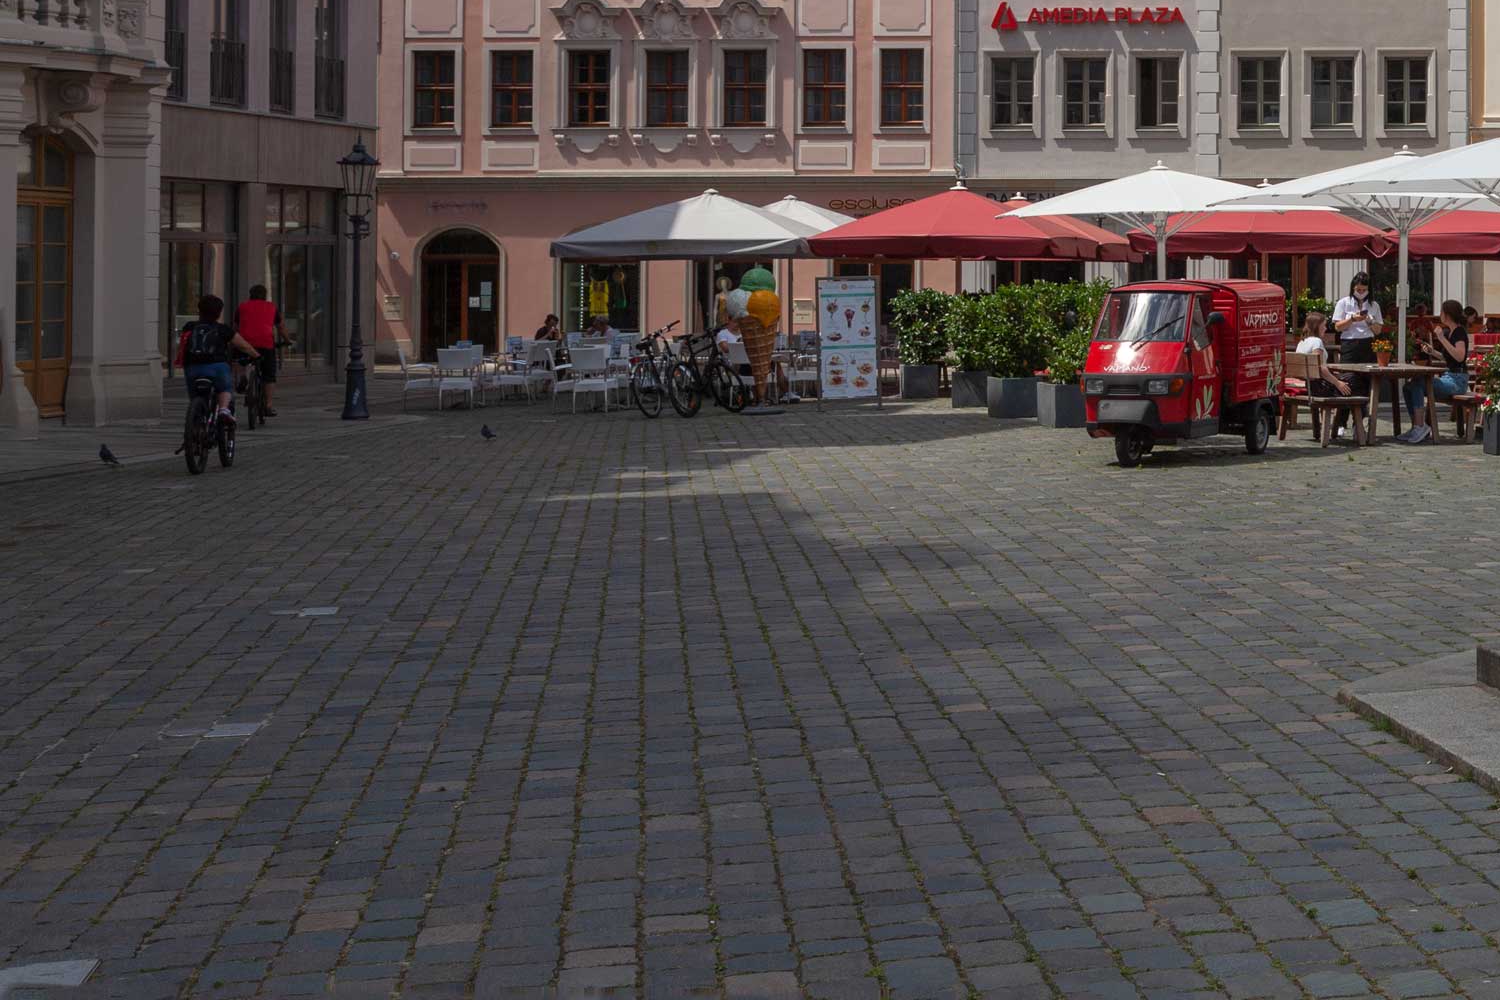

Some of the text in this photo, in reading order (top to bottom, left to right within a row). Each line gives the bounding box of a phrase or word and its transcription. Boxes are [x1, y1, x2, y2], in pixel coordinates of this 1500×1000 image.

[1027, 7, 1185, 24] AMEDIA PLAZA
[1244, 311, 1278, 328] VAPIANO
